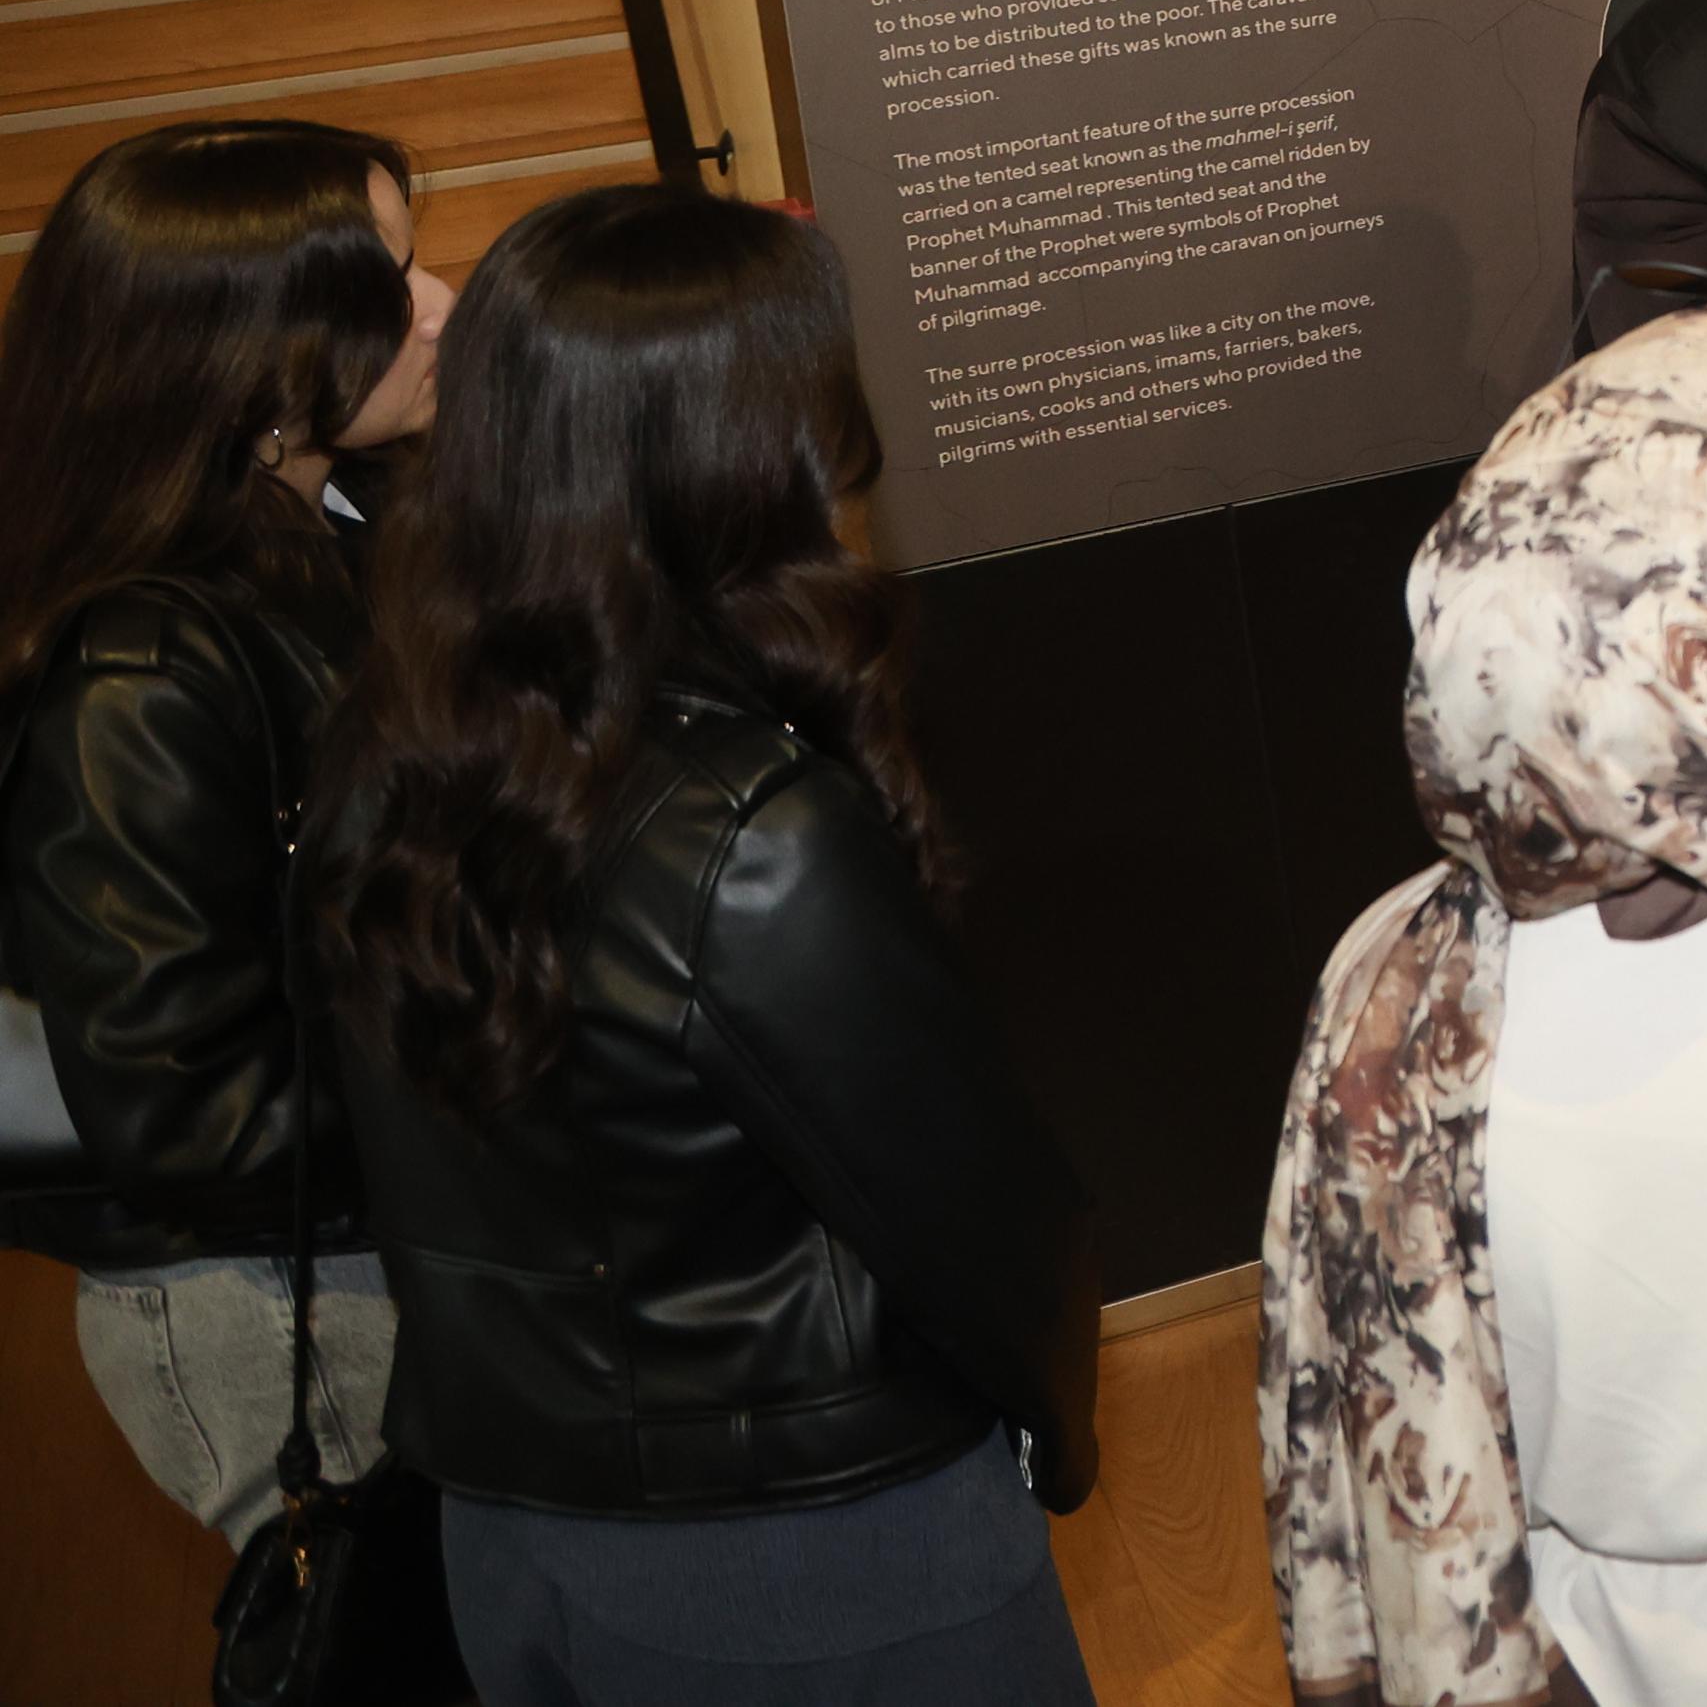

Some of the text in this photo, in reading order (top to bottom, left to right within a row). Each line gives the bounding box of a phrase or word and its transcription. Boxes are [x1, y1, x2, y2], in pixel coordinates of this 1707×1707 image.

[924, 294, 1375, 384] The surre procession was like a city on the move,
[929, 322, 1362, 411] with its own physicians, imams, farriers, bakers,
[934, 346, 1362, 438] musicians, cooks and others who provided the
[938, 398, 1233, 468] pilgrims with essential services.
